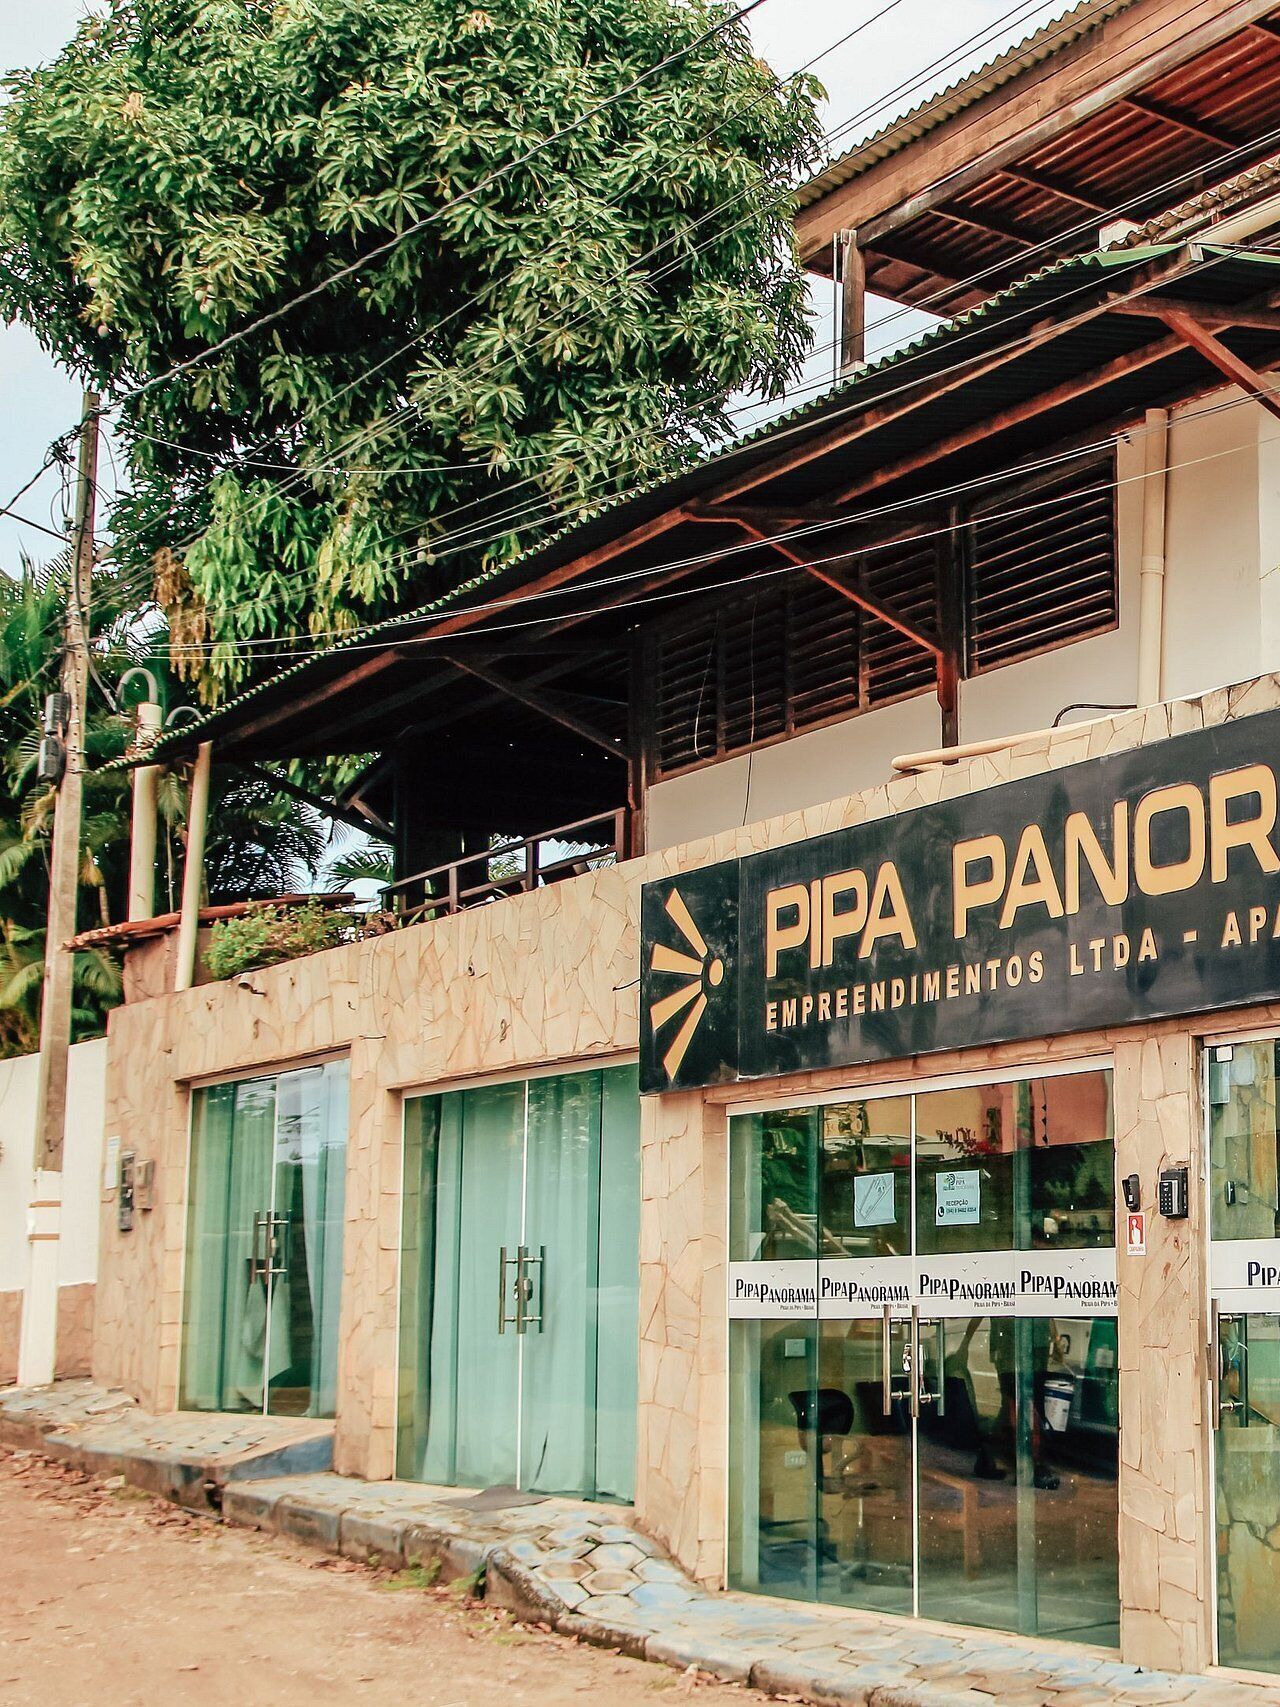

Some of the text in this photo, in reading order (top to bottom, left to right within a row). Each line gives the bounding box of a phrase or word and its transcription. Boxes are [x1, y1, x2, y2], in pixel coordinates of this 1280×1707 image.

[766, 861, 917, 978] PIPA
[766, 950, 1044, 1032] EMPREENDIMENTOS
[1070, 927, 1158, 976] LTDA
